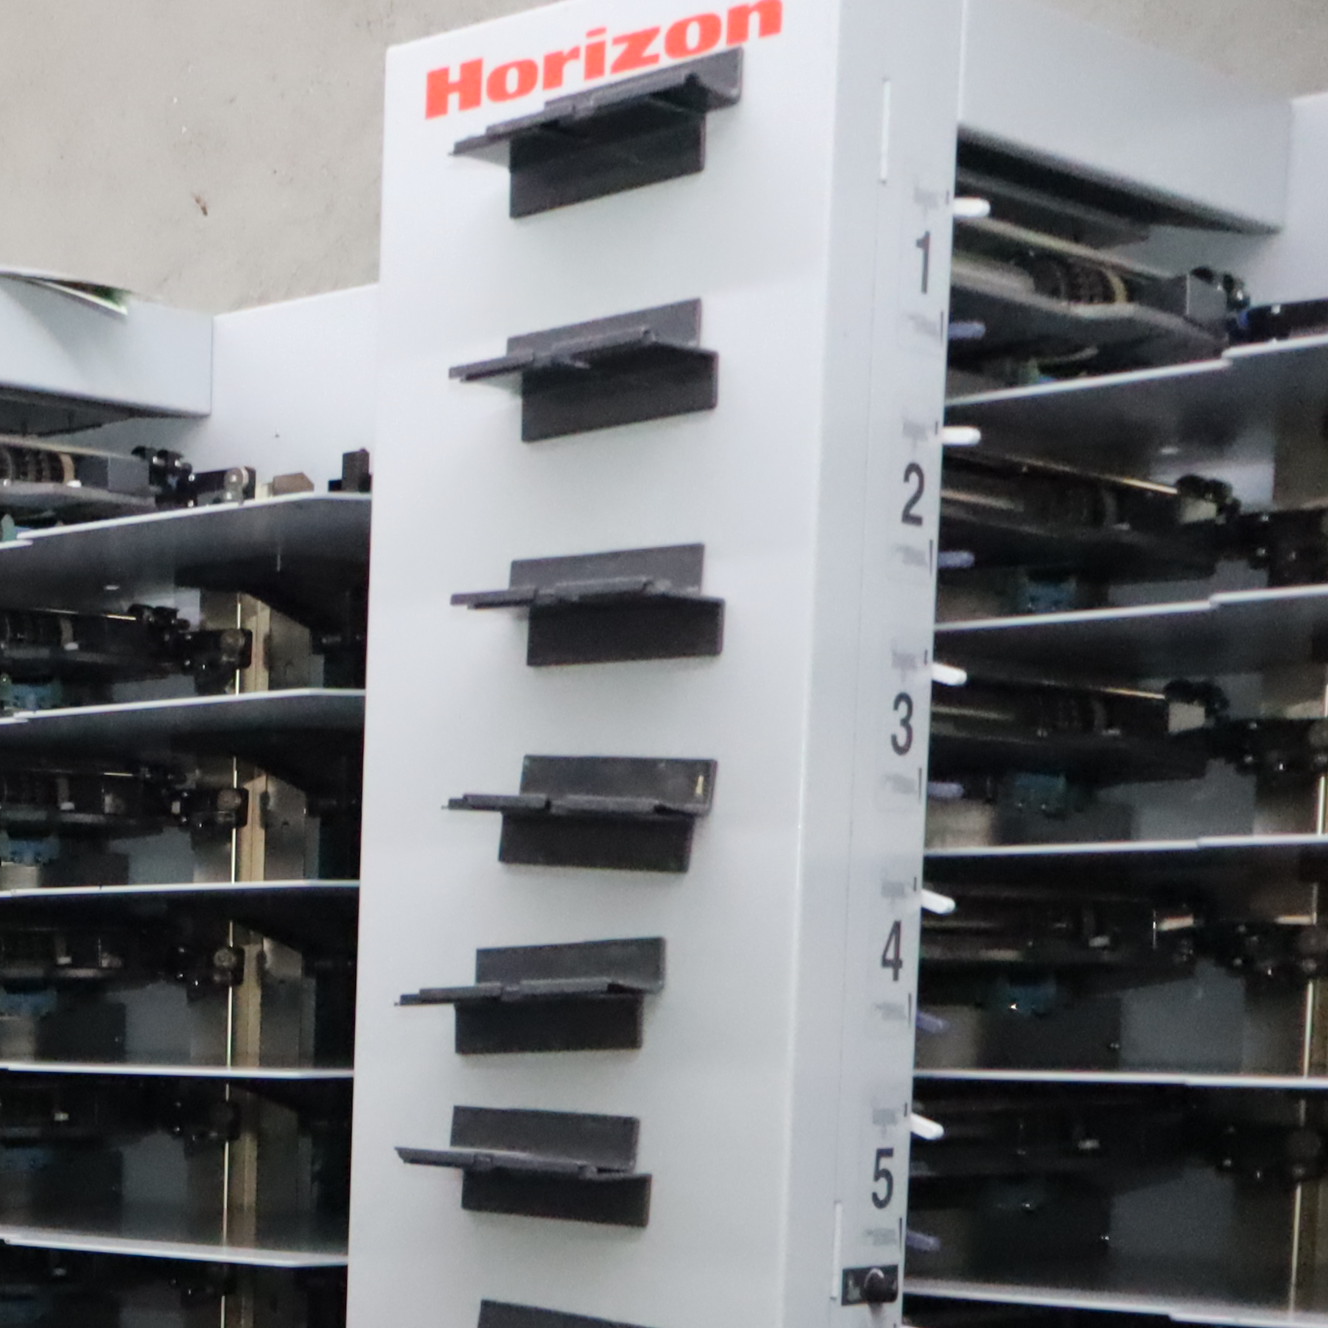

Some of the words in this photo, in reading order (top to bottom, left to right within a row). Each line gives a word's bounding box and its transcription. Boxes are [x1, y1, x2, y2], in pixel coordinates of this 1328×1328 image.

[424, 0, 784, 119] Horizon
[915, 230, 931, 295] 1
[901, 462, 925, 527] 2
[891, 692, 914, 756] 3
[881, 920, 904, 982] 4
[871, 1147, 894, 1210] 5
